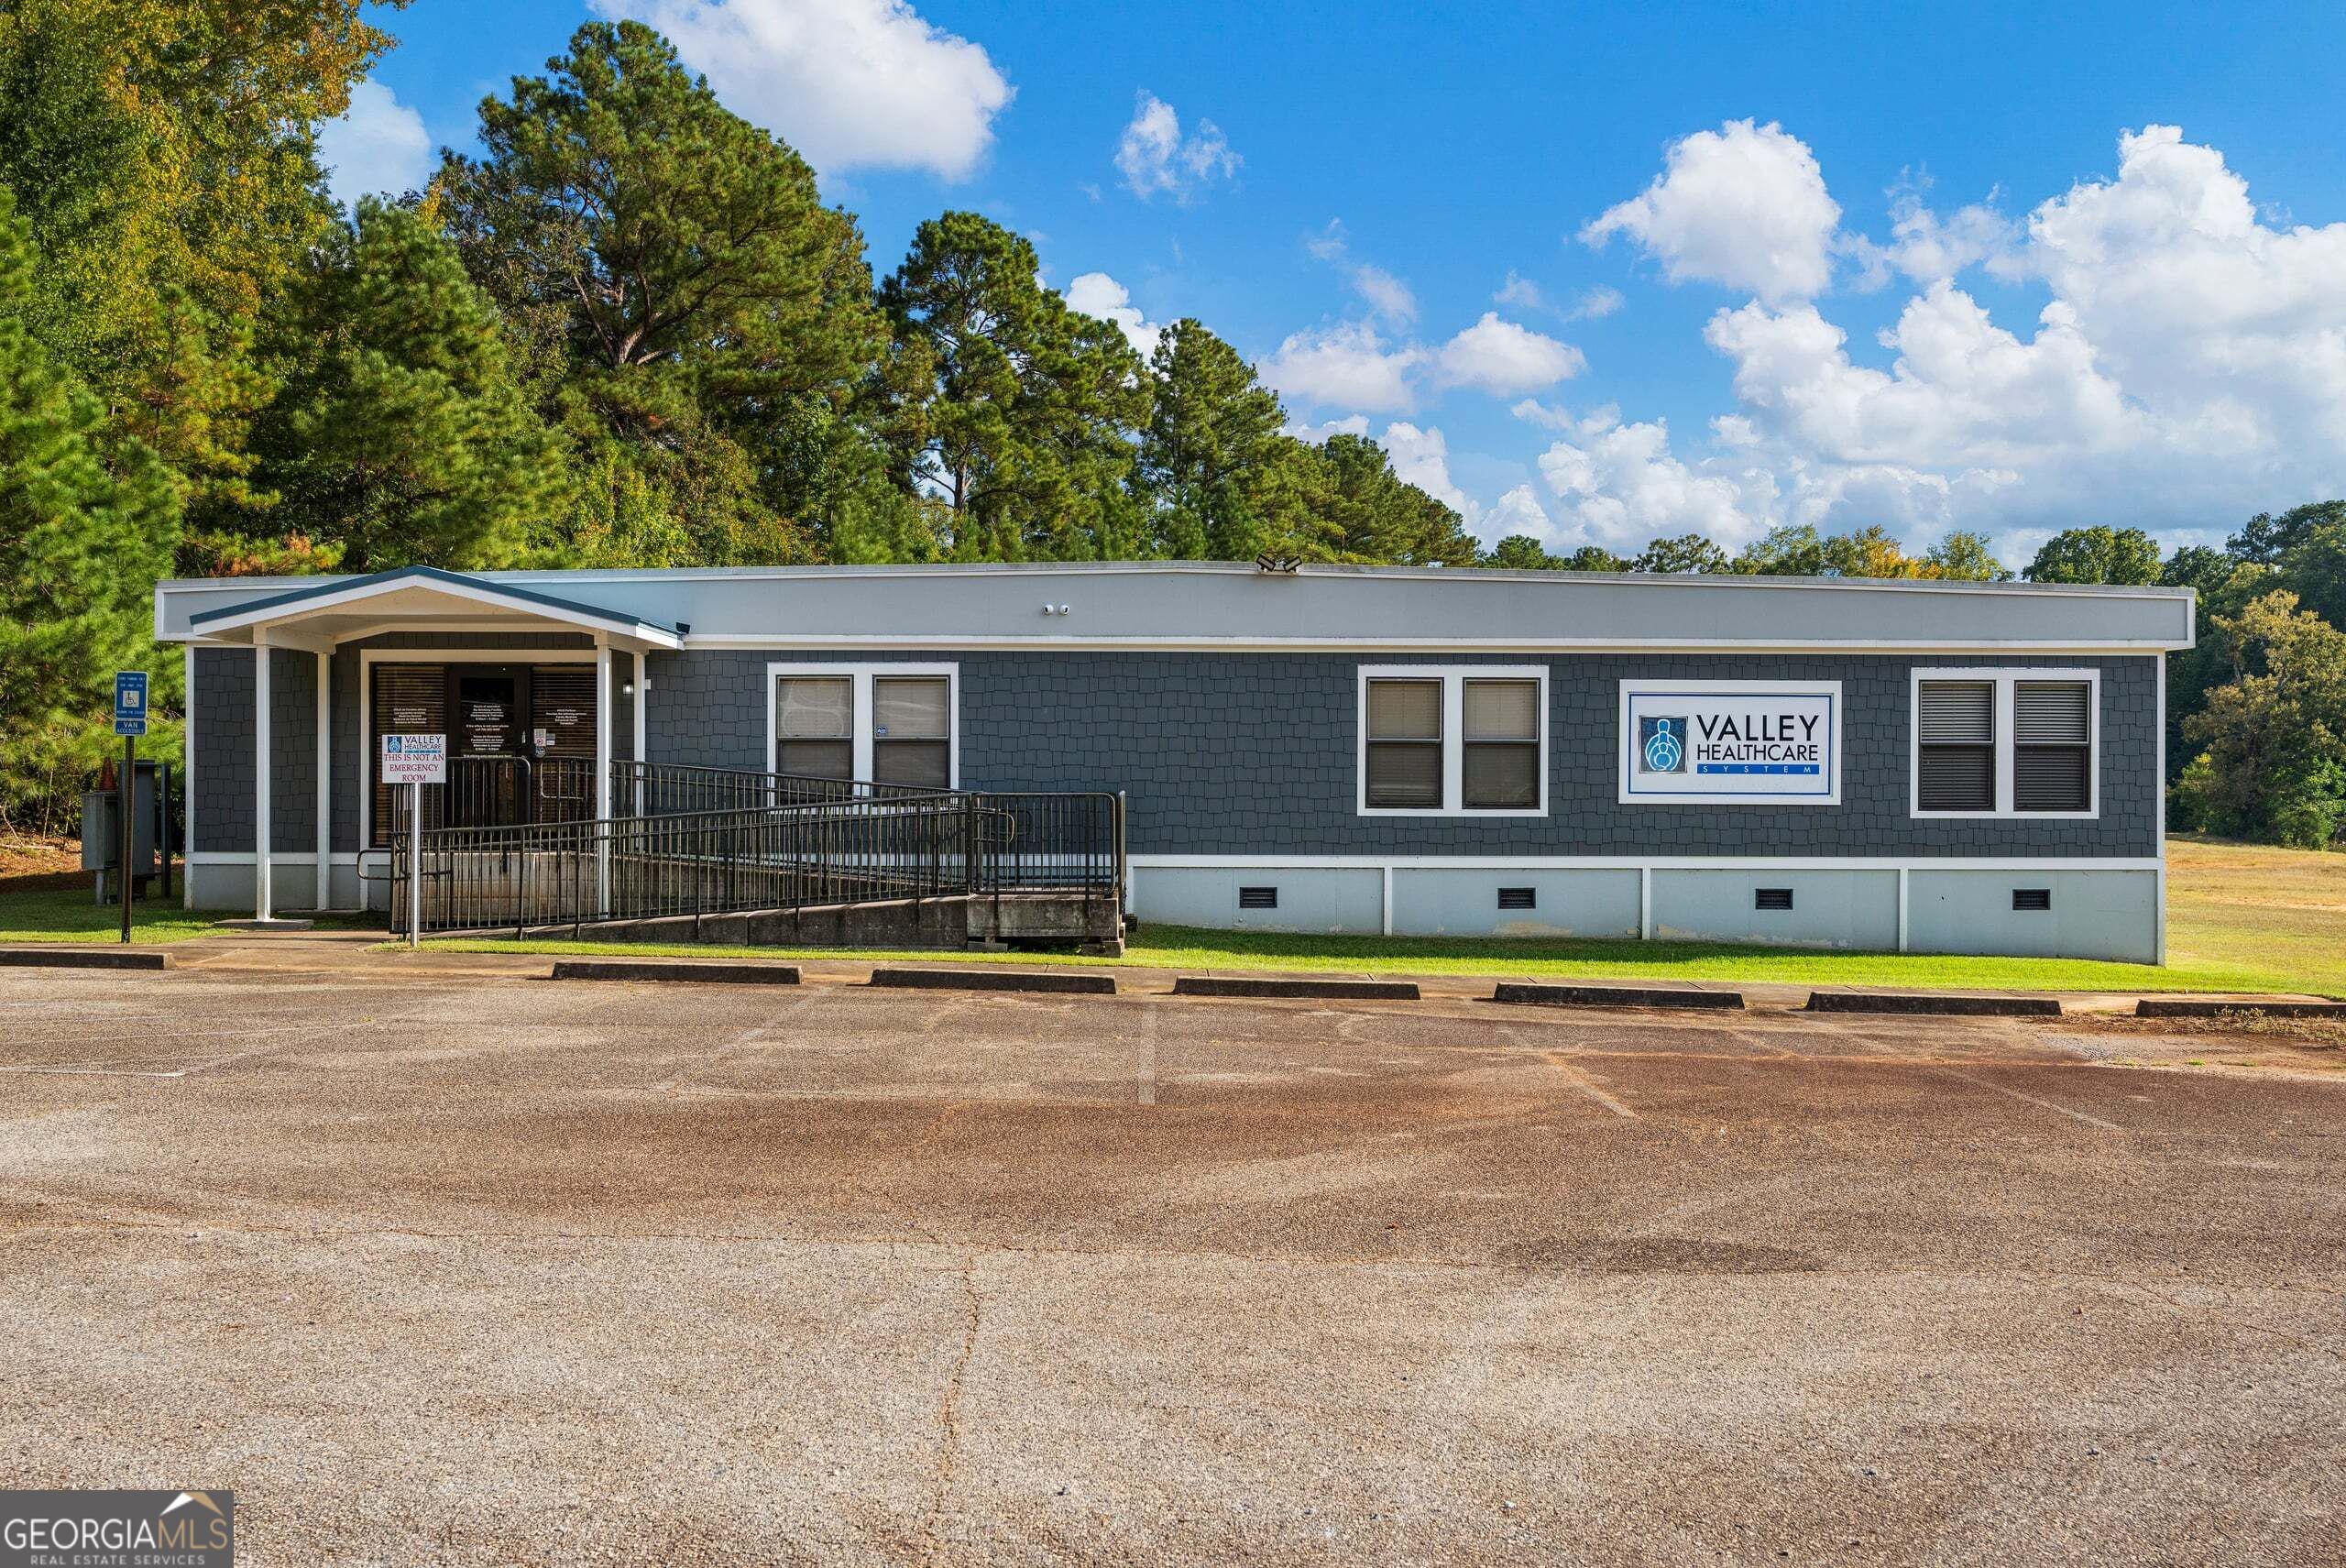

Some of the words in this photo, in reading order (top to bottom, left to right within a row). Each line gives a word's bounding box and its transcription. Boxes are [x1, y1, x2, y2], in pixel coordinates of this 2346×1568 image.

[1696, 715, 1819, 741] VALLEY
[1697, 744, 1818, 761] HEALTHCARE
[1704, 765, 1811, 773] SYSTEM
